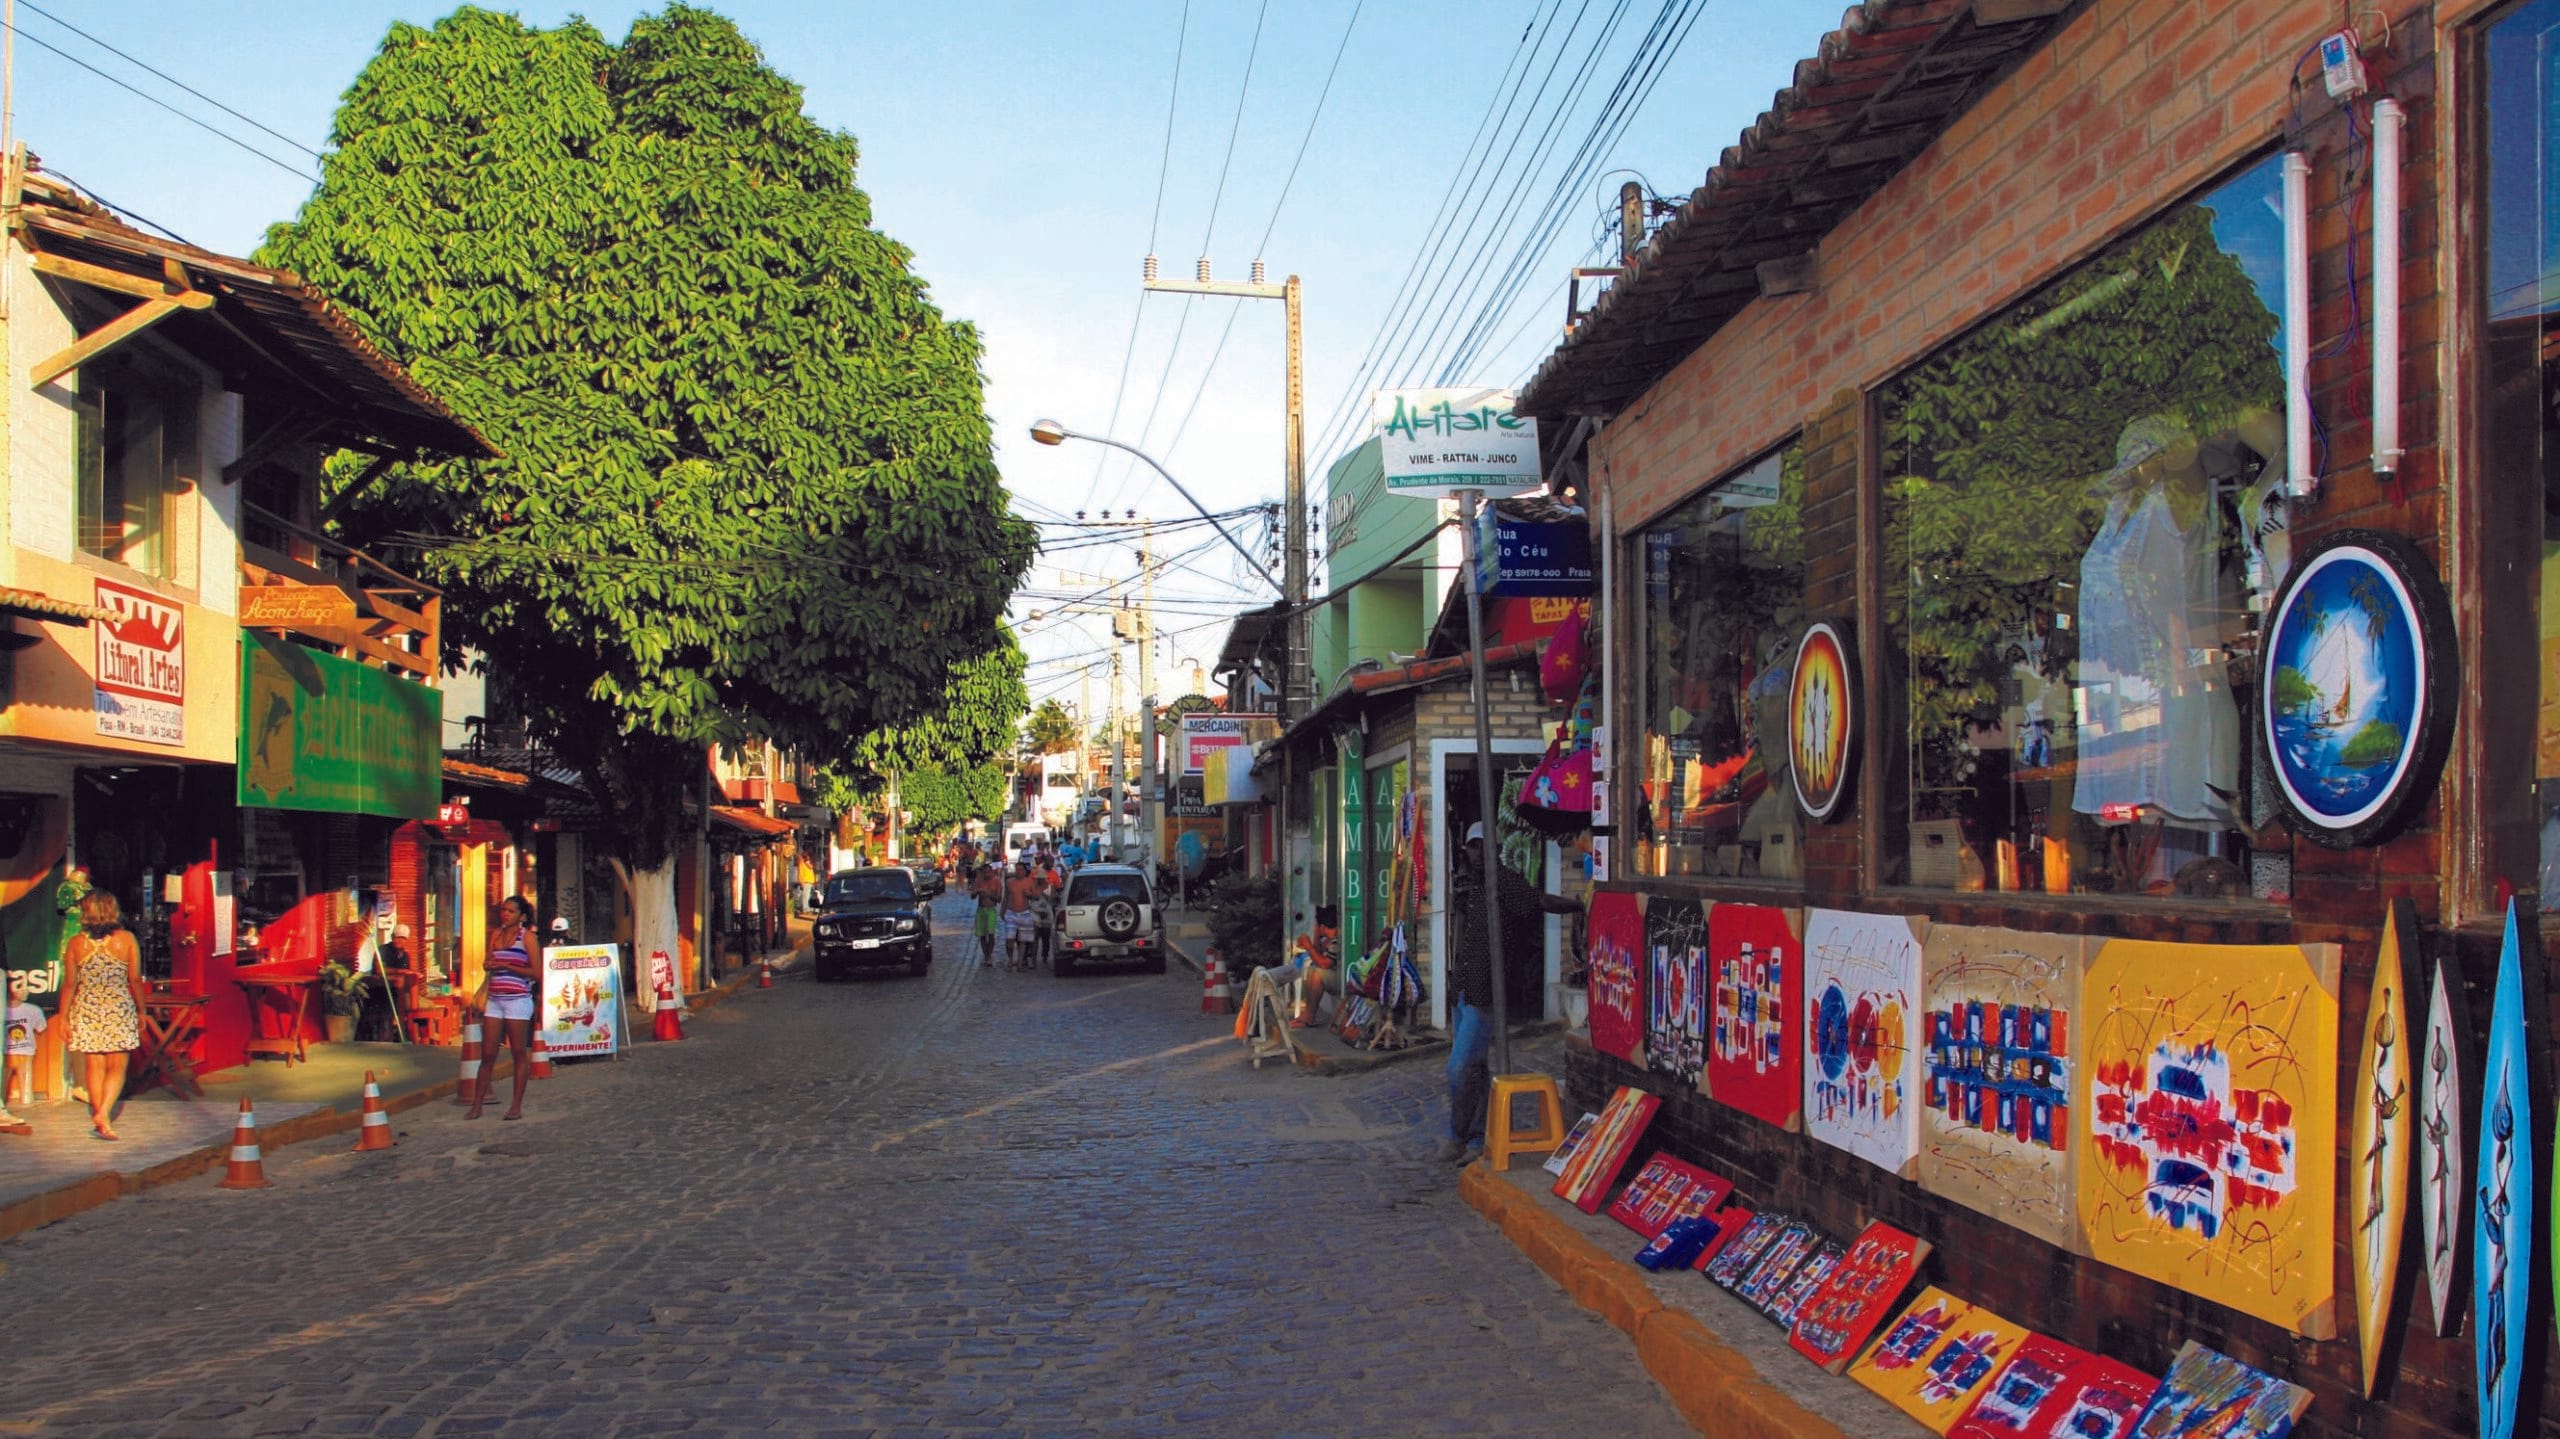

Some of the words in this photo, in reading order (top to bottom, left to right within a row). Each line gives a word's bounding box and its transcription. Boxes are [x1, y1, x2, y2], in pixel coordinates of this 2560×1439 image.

[1384, 395, 1527, 442] Abitare
[1409, 454, 1434, 464] VIME
[1442, 453, 1479, 463] RATTAN
[1486, 454, 1518, 463] JUNCO
[1399, 476, 1428, 486] Prudente
[1521, 544, 1548, 557] Céu
[1499, 568, 1513, 580] ep
[1515, 568, 1561, 577] 59178-000
[1568, 566, 1592, 577] Praia
[264, 588, 320, 601] Pousada
[242, 596, 334, 625] Aconchego
[103, 641, 145, 688] Litoral
[148, 650, 180, 693] Artes
